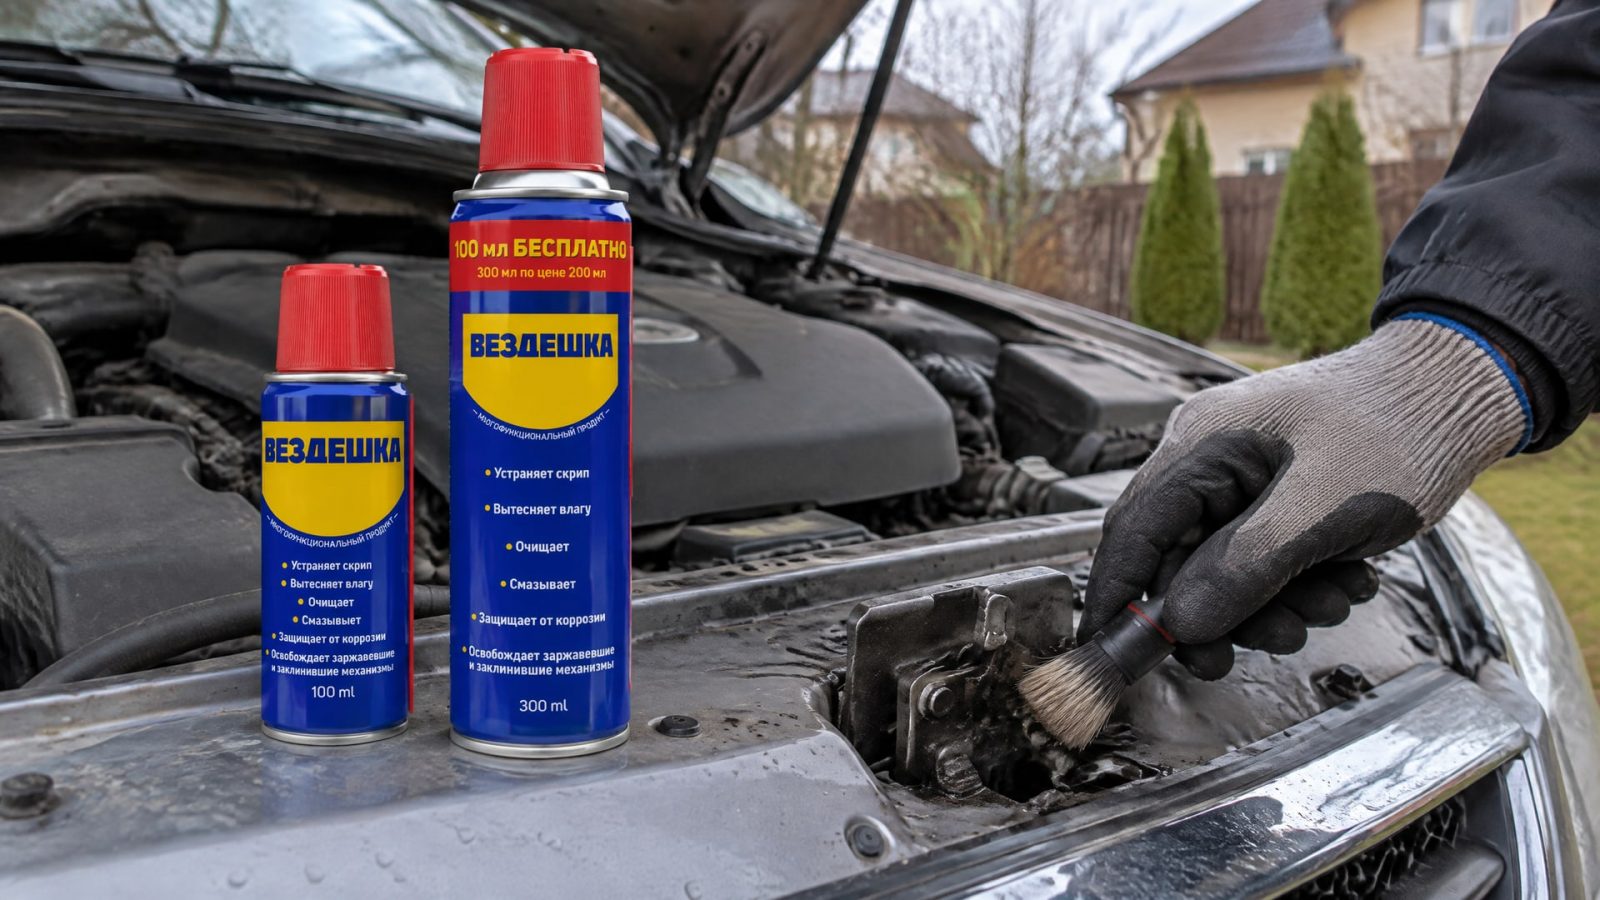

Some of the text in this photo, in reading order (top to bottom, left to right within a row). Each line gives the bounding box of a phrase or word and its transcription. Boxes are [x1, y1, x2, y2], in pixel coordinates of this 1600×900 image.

[455, 238, 627, 259] 100 мл БЕСПЛАТНО
[477, 266, 607, 280] 300 мл по цене 200 мл
[470, 333, 614, 359] ВЕЗДЕШКА
[265, 437, 401, 464] ВЕЗДЕШКА
[494, 467, 590, 482] Устраняет скрип
[493, 503, 592, 517] Вытесняет влагу
[515, 540, 570, 554] Очищает
[291, 560, 373, 573] Устраняет скрип
[290, 578, 374, 591] Вытесняет влагу
[509, 578, 577, 590] Смазывает
[308, 597, 355, 608] Очищает
[479, 611, 606, 628] Защищает от коррозии
[278, 631, 386, 645] Защищает от коррозии
[271, 648, 395, 665] Освобождает заржавевшие
[468, 645, 616, 663] Освобождает заржавевшие
[271, 663, 395, 676] и заклинившие механизмы
[469, 660, 615, 676] и заклинившие механизмы
[311, 685, 356, 698] 100 ml
[519, 699, 569, 712] 300 ml
